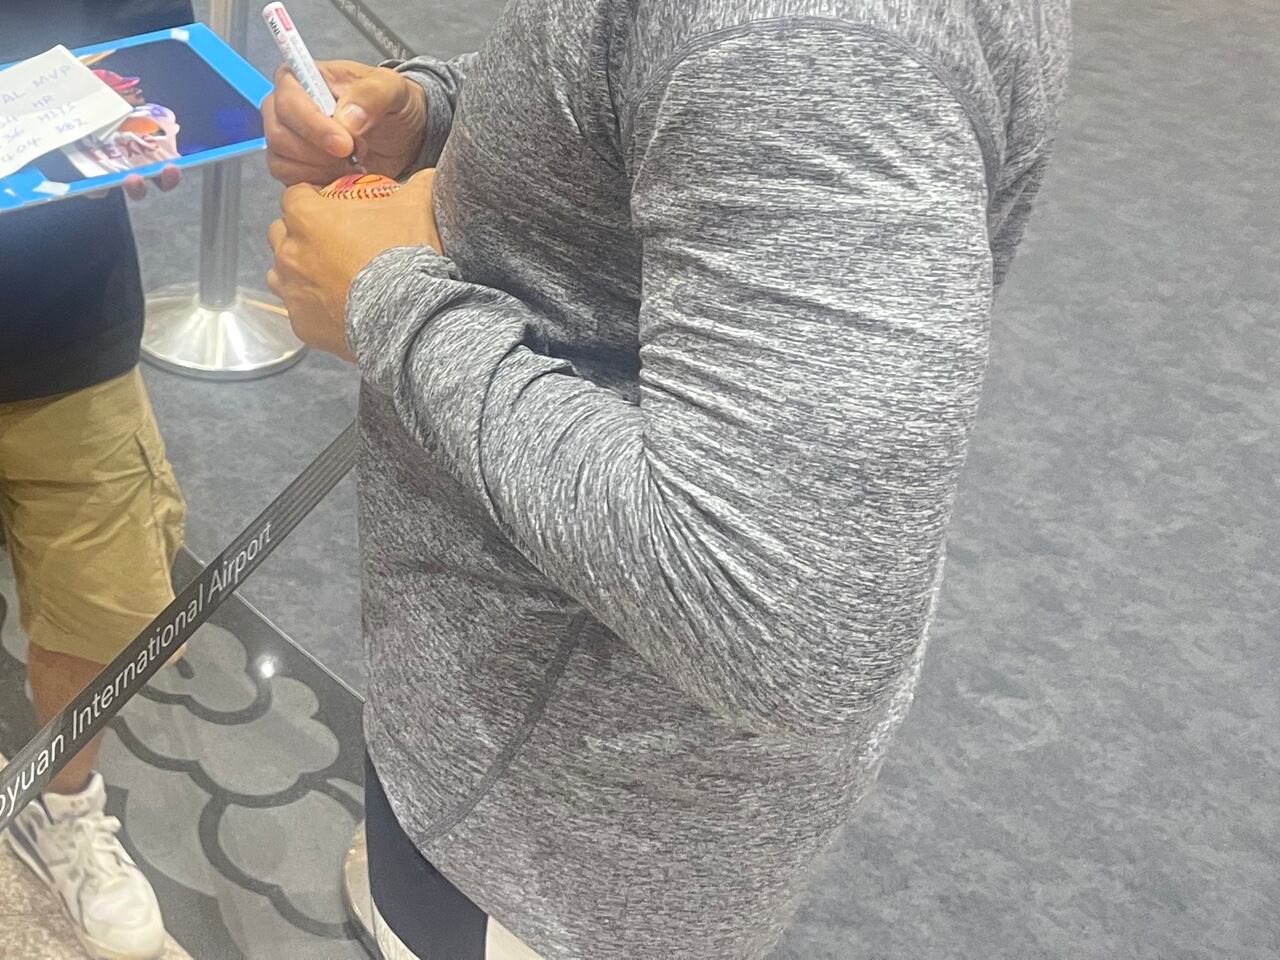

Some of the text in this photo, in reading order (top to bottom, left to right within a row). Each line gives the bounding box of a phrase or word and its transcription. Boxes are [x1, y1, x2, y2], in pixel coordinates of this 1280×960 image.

[32, 64, 71, 87] MVP
[71, 583, 205, 742] International
[207, 523, 273, 602] Airport
